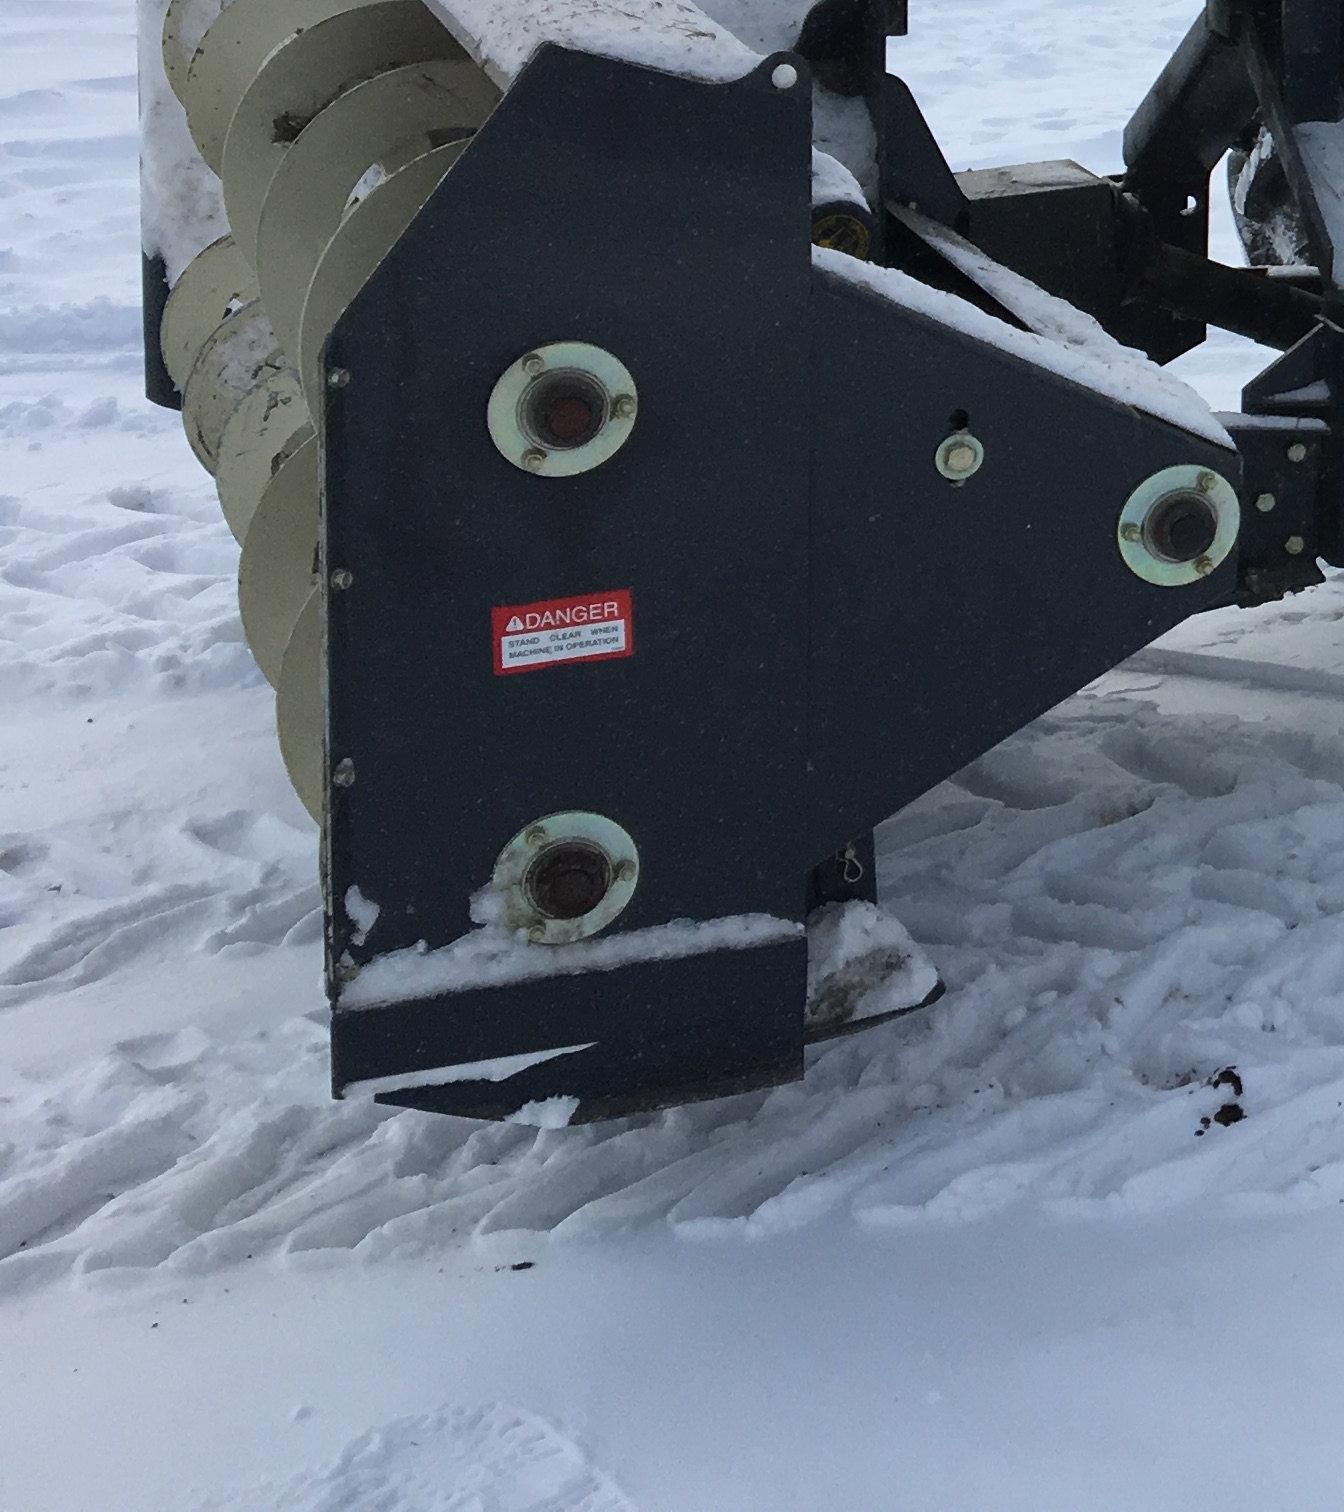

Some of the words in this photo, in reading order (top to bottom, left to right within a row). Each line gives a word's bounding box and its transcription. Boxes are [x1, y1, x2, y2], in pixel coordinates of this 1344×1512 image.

[525, 602, 618, 629] DANGER
[508, 637, 540, 648] STAND
[549, 631, 581, 642] CLEAR
[590, 626, 618, 636] WHEN
[509, 646, 552, 658] MACHINE
[565, 636, 619, 650] OPERATION
